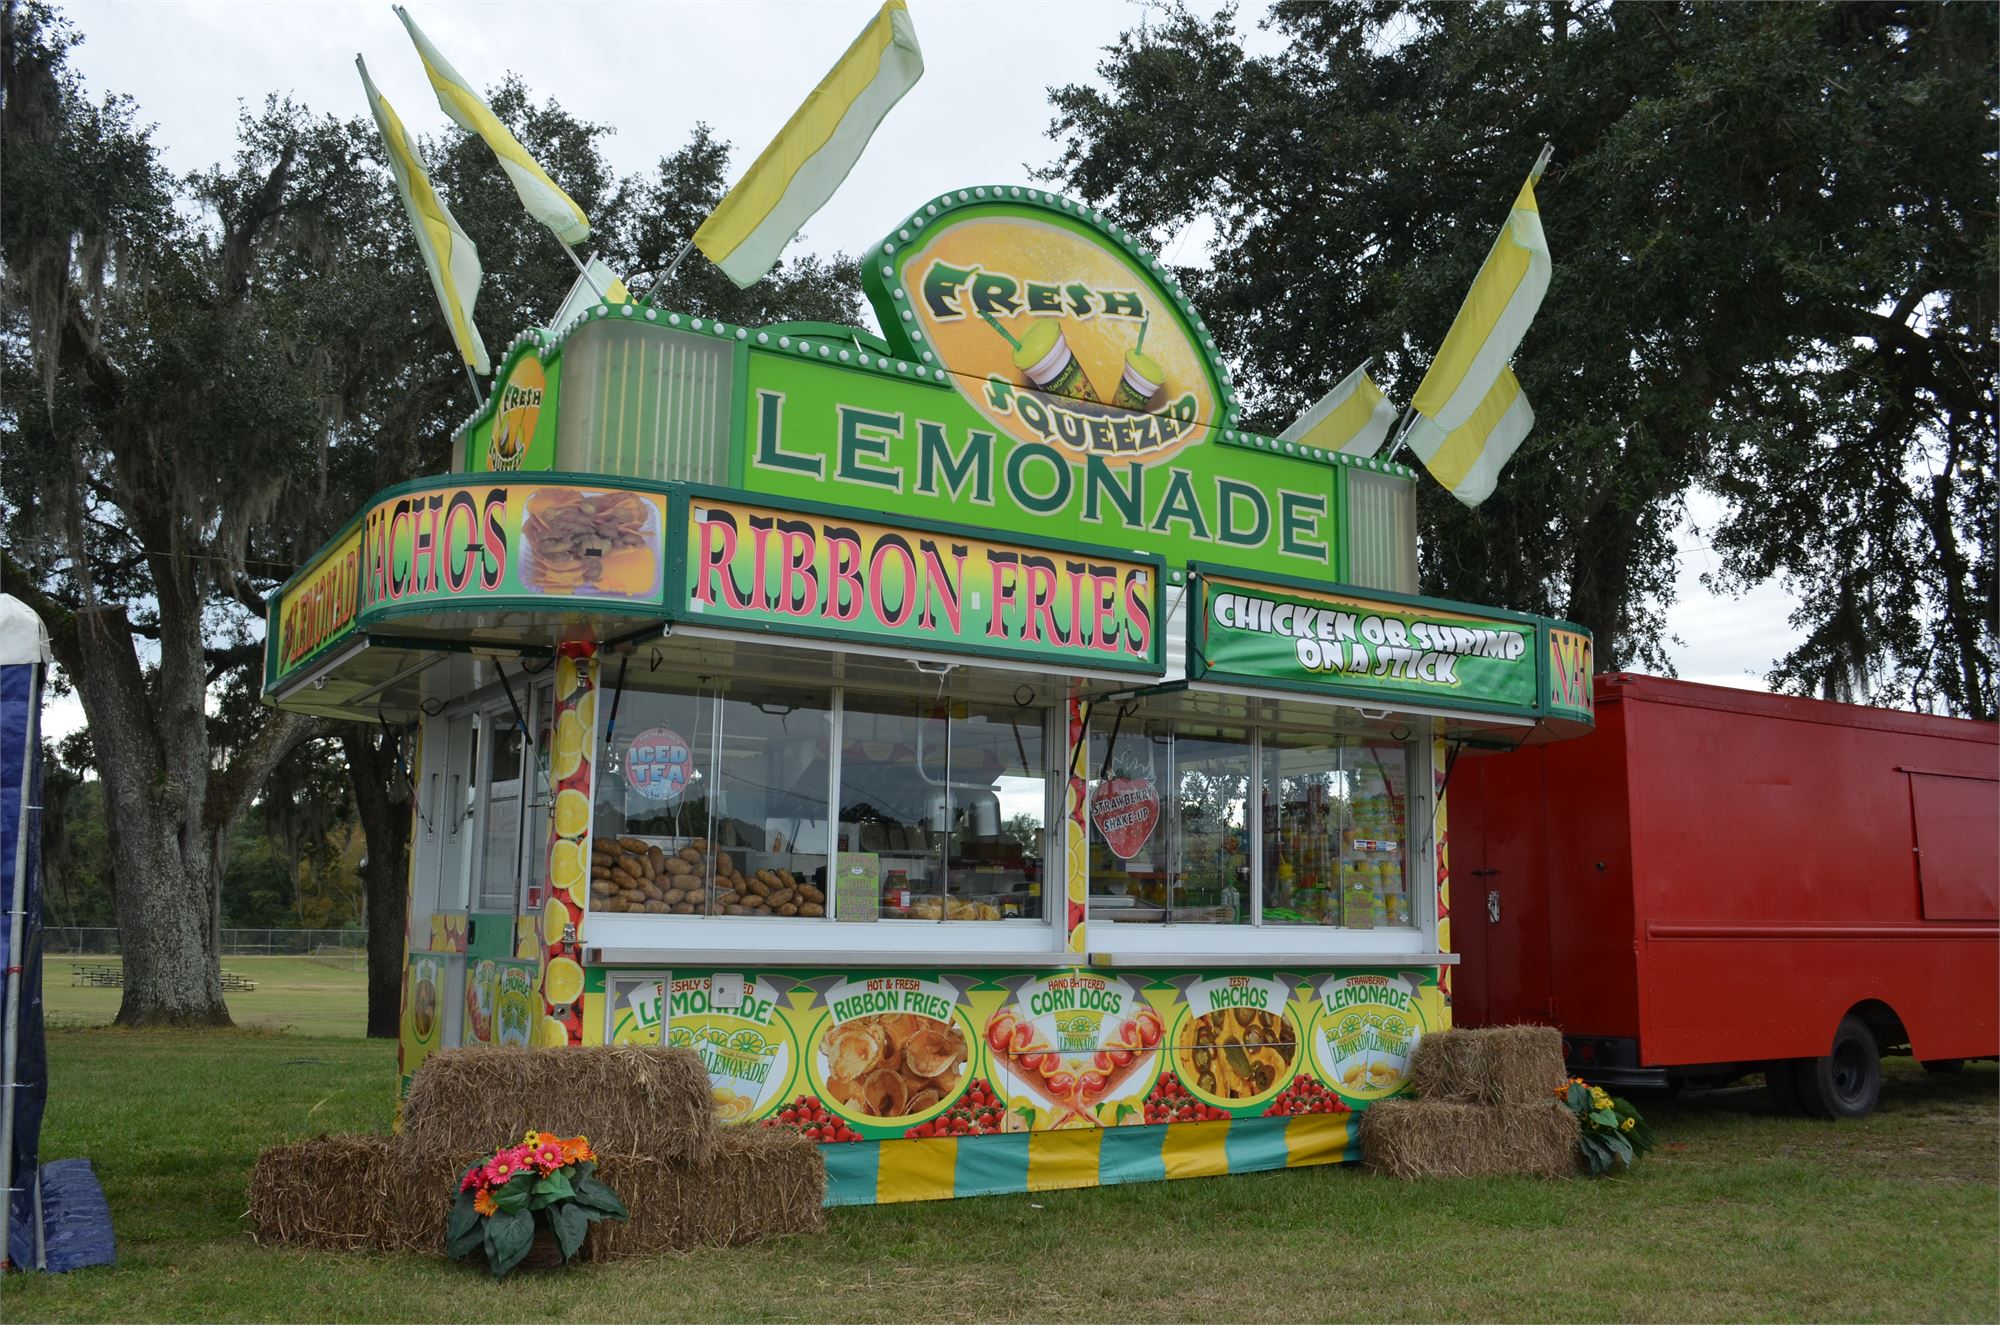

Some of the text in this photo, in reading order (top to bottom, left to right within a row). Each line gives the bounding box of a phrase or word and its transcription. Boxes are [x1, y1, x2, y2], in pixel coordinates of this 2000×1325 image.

[922, 260, 1147, 322] FRESH
[503, 384, 542, 413] FRESH
[984, 373, 1198, 455] SQUEEZED
[754, 389, 1328, 563] LEMONADE
[362, 488, 507, 612] NACHOS
[691, 506, 1151, 656] RIBBON FRIES
[289, 544, 362, 667] LEMONAD
[1213, 593, 1525, 661] CHICKEN OR SHRIMP
[1295, 638, 1459, 685] ON A STICK
[629, 745, 688, 765] ICED
[632, 764, 684, 784] TEA
[1093, 788, 1153, 816] STRAWBERRY
[1104, 807, 1149, 832] SHAKE-UP
[657, 979, 700, 996] FESHLY
[867, 979, 920, 991] HOT & FRESH
[1048, 979, 1068, 991] HAND
[1229, 977, 1249, 987] ZESTY
[1346, 976, 1389, 987] STRAWBERRY
[639, 990, 773, 1025] LEMODE
[833, 990, 950, 1022] RIBBON FRIES
[1030, 988, 1122, 1015] CORN DOGS
[1209, 987, 1268, 1010] NACHOS
[1326, 985, 1409, 1013] LEMONADE
[1059, 1036, 1097, 1051] LEMONADE
[1369, 1033, 1410, 1059] LEMONADE
[708, 1052, 769, 1084] LEMONADE
